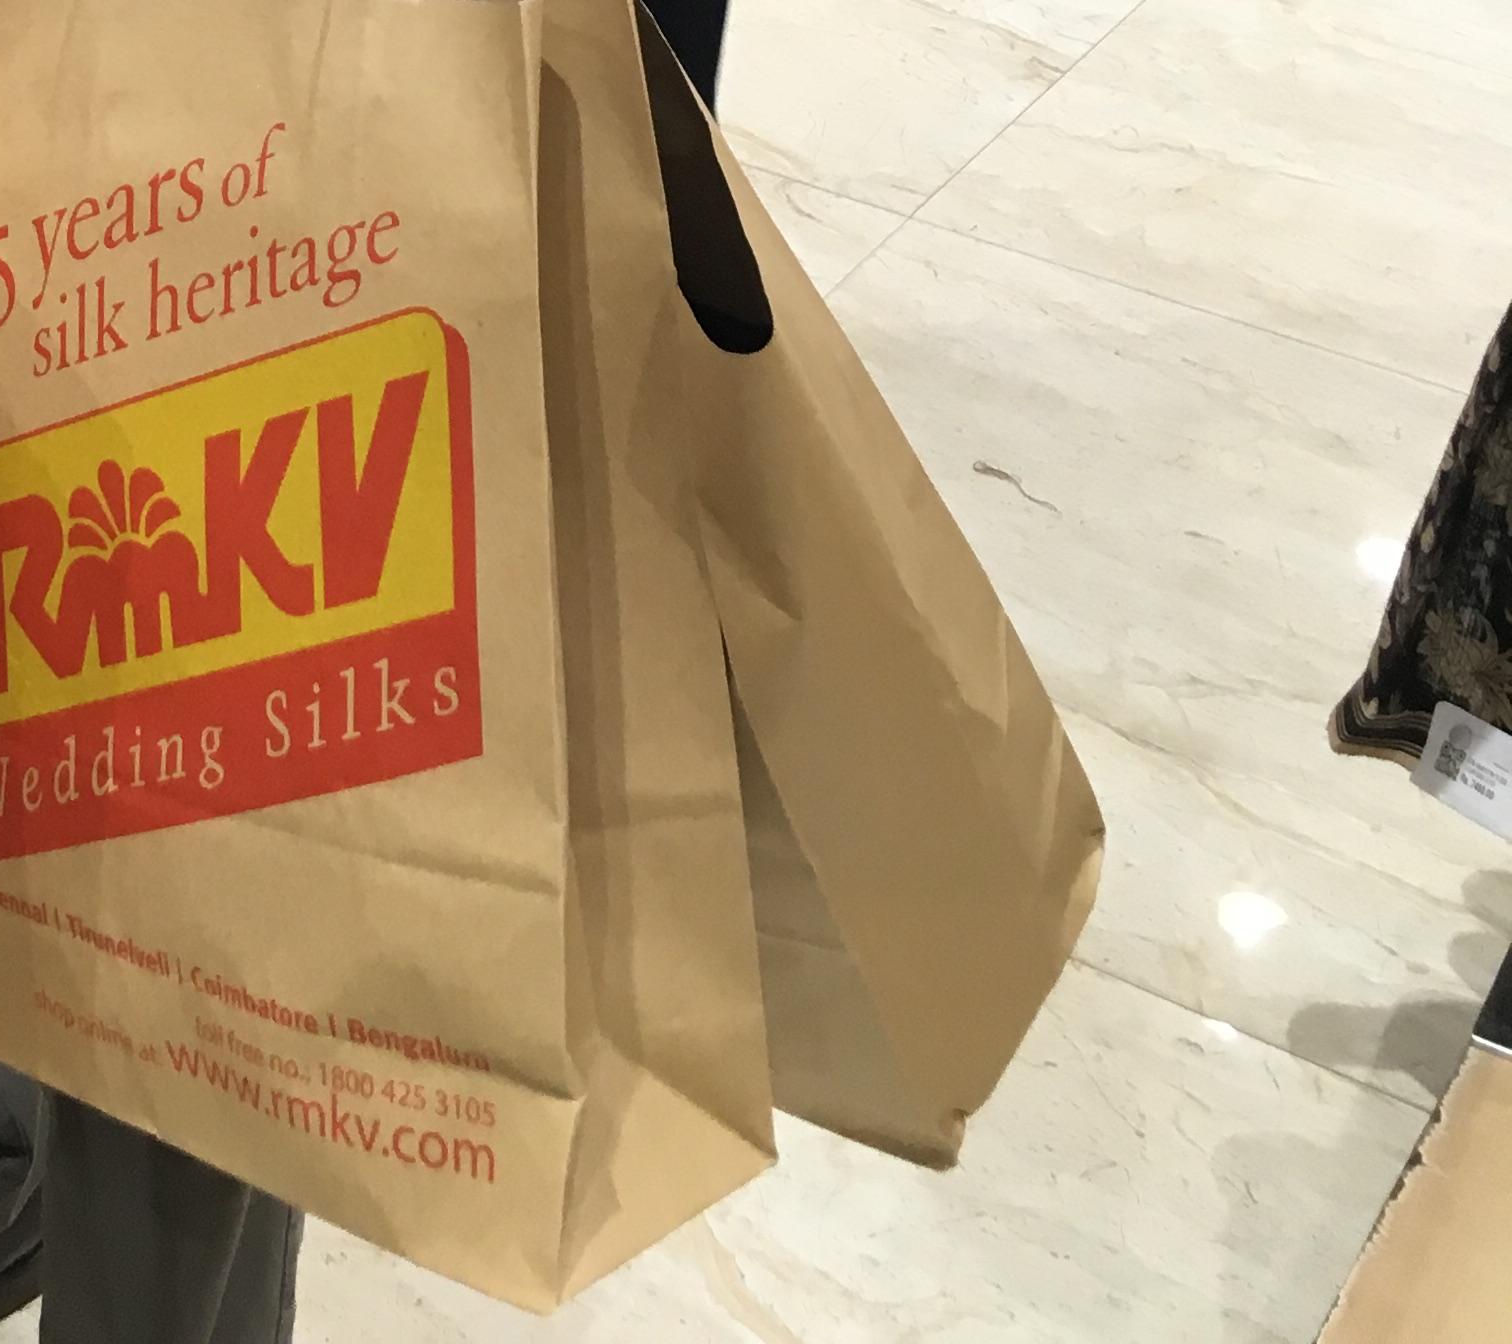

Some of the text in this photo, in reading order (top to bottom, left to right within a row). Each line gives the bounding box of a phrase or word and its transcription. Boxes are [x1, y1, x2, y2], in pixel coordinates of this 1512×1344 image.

[31, 157, 206, 310] years
[221, 121, 286, 208] of
[31, 209, 401, 379] silk heritage
[264, 657, 460, 759] Silks
[66, 913, 170, 977] Tirunelveli
[191, 967, 319, 1034] Coimbatore
[347, 1018, 490, 1071] Bengaluru
[165, 1040, 495, 1184] www.rmkv.com
[320, 1063, 374, 1099] 1800
[381, 1079, 426, 1110] 425
[435, 1088, 495, 1127] 3105
